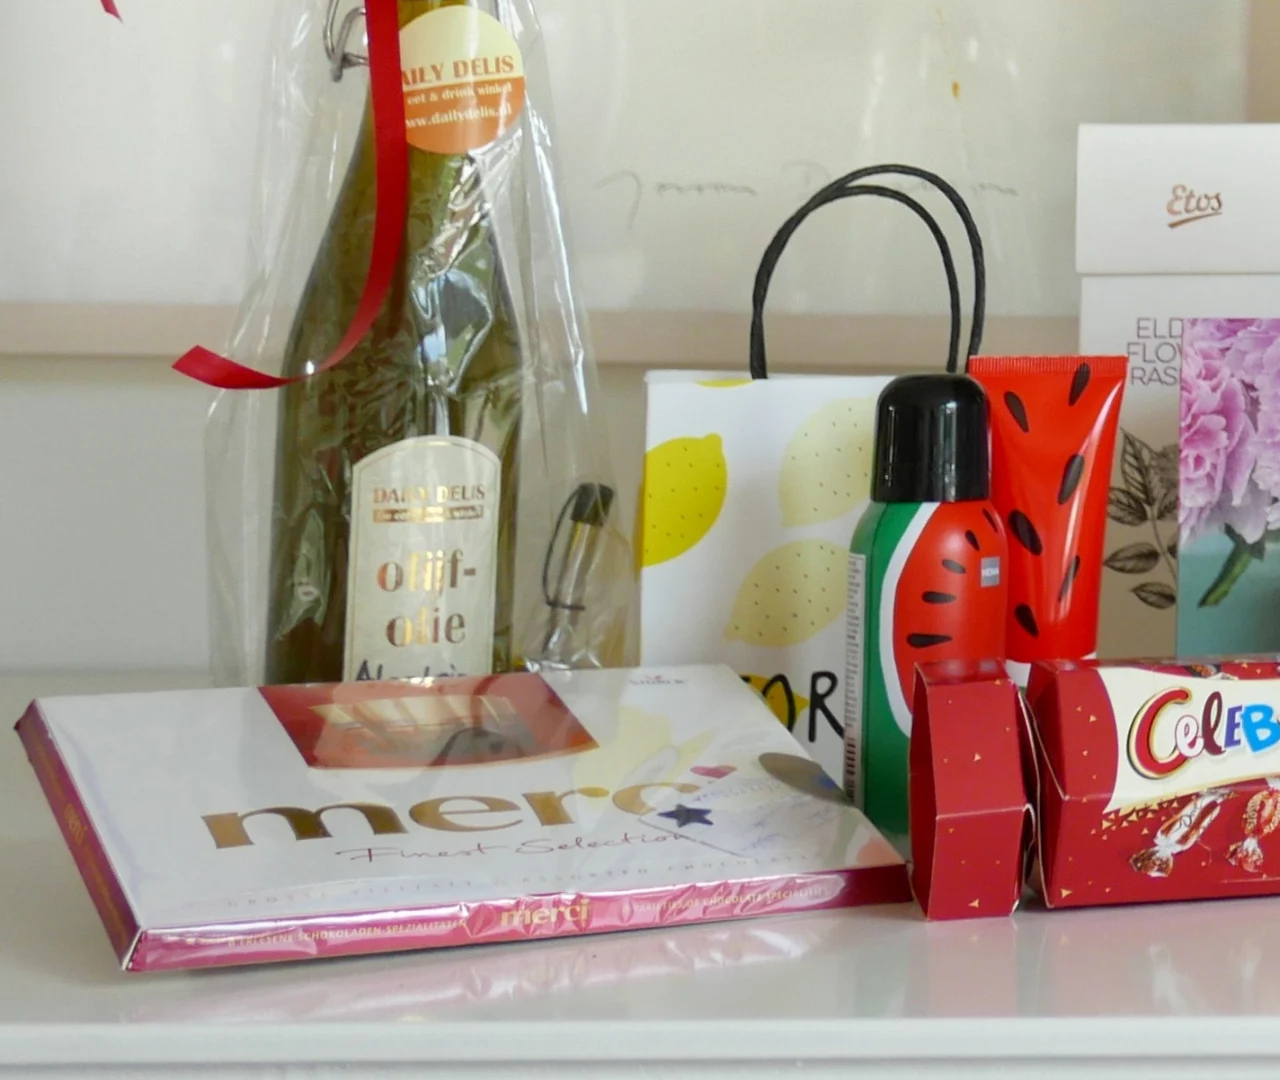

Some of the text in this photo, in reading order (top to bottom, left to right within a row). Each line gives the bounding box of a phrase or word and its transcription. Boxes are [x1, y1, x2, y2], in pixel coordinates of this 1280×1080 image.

[401, 55, 515, 87] AILY DELIS
[1166, 184, 1223, 217] Etos
[1136, 317, 1185, 340] ELD
[1130, 366, 1183, 387] RAS
[386, 607, 466, 648] olie
[501, 897, 592, 927] merci
